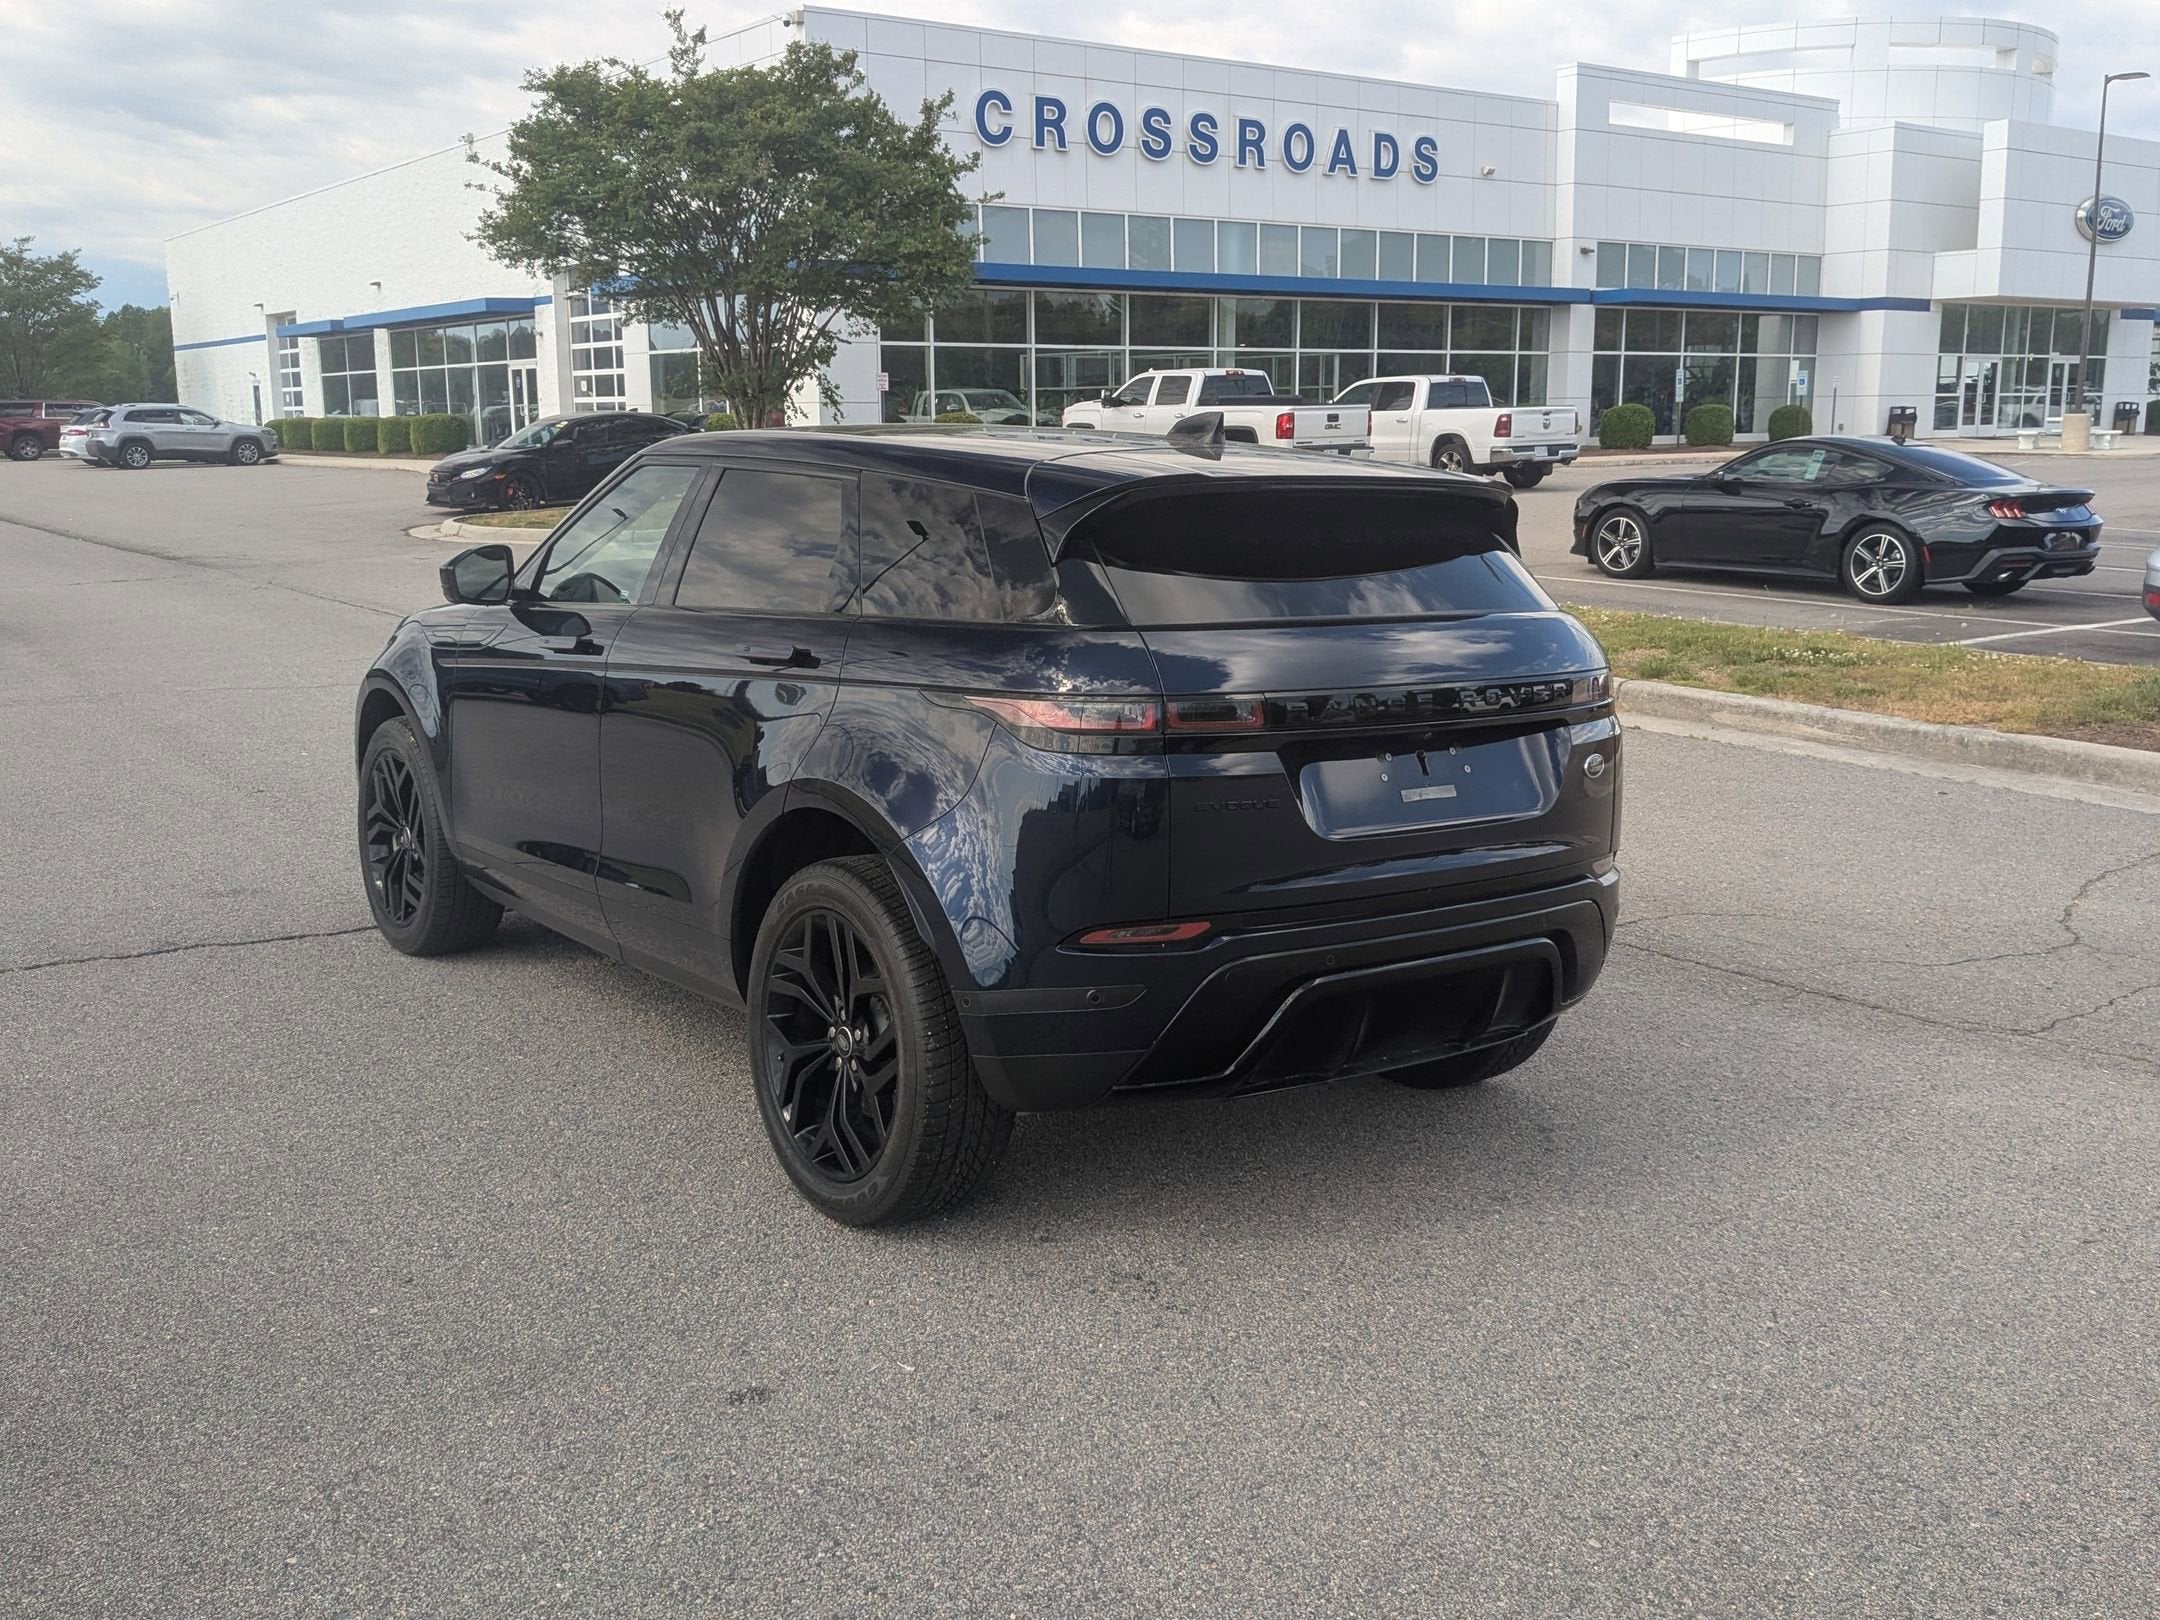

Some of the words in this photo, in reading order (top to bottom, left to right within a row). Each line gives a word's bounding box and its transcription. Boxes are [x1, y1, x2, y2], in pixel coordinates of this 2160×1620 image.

[973, 88, 1440, 184] CROSSROADS
[2097, 205, 2128, 232] Ford
[1285, 691, 1434, 722] RANGE
[1459, 682, 1569, 709] ROVER
[1192, 797, 1280, 814] EVOQUE
